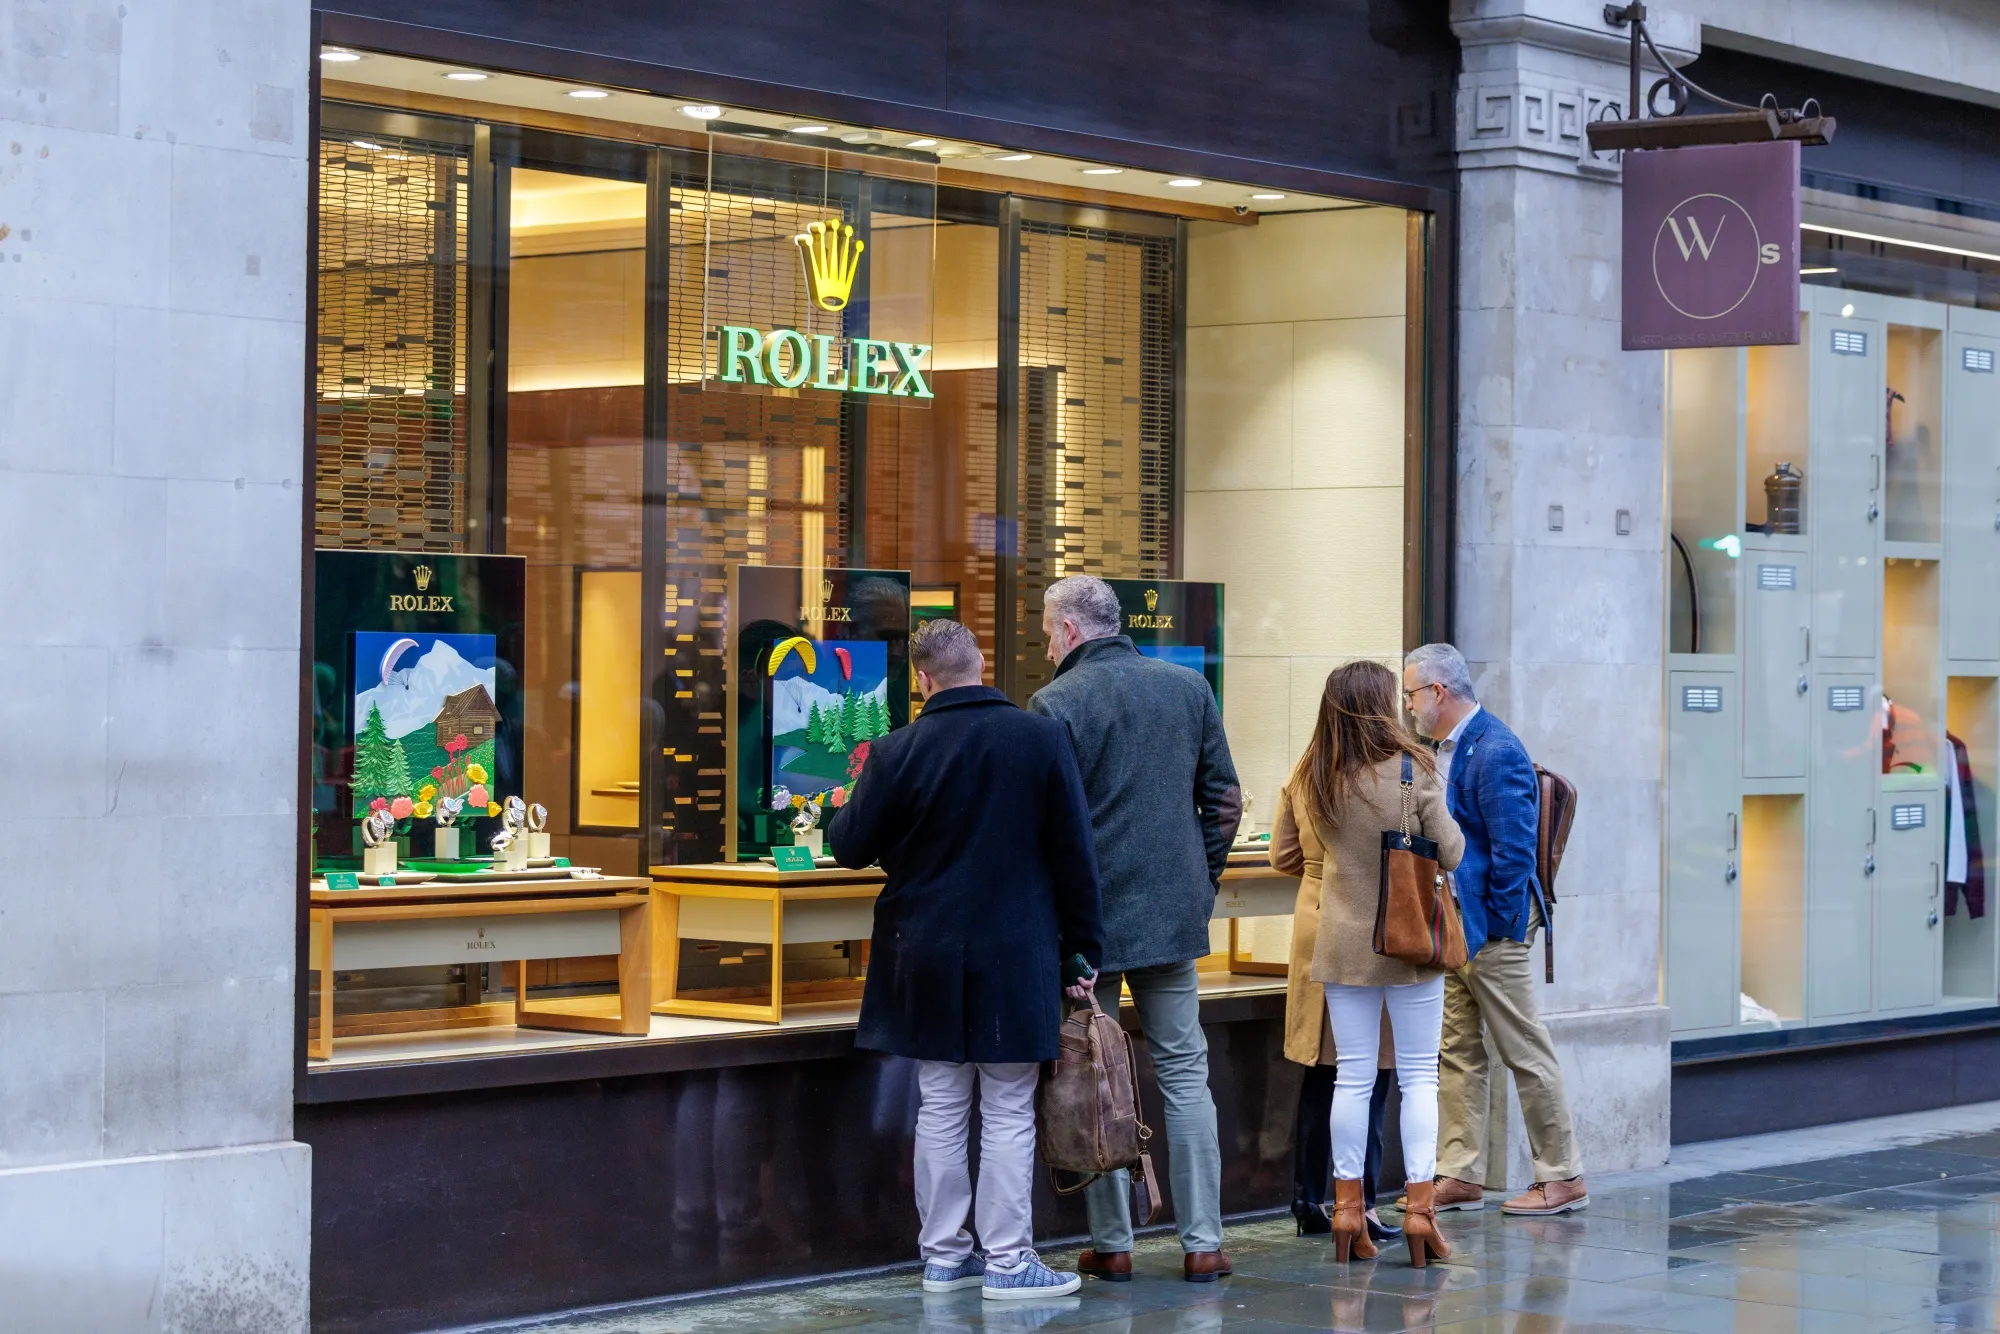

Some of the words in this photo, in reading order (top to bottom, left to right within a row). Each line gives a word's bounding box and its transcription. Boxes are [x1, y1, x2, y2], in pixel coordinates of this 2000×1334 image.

[714, 325, 934, 398] ROLEX
[390, 594, 454, 612] ROLEX
[800, 606, 852, 622] ROLEX
[1128, 614, 1174, 629] ROLEX
[466, 940, 496, 950] ROLEX
